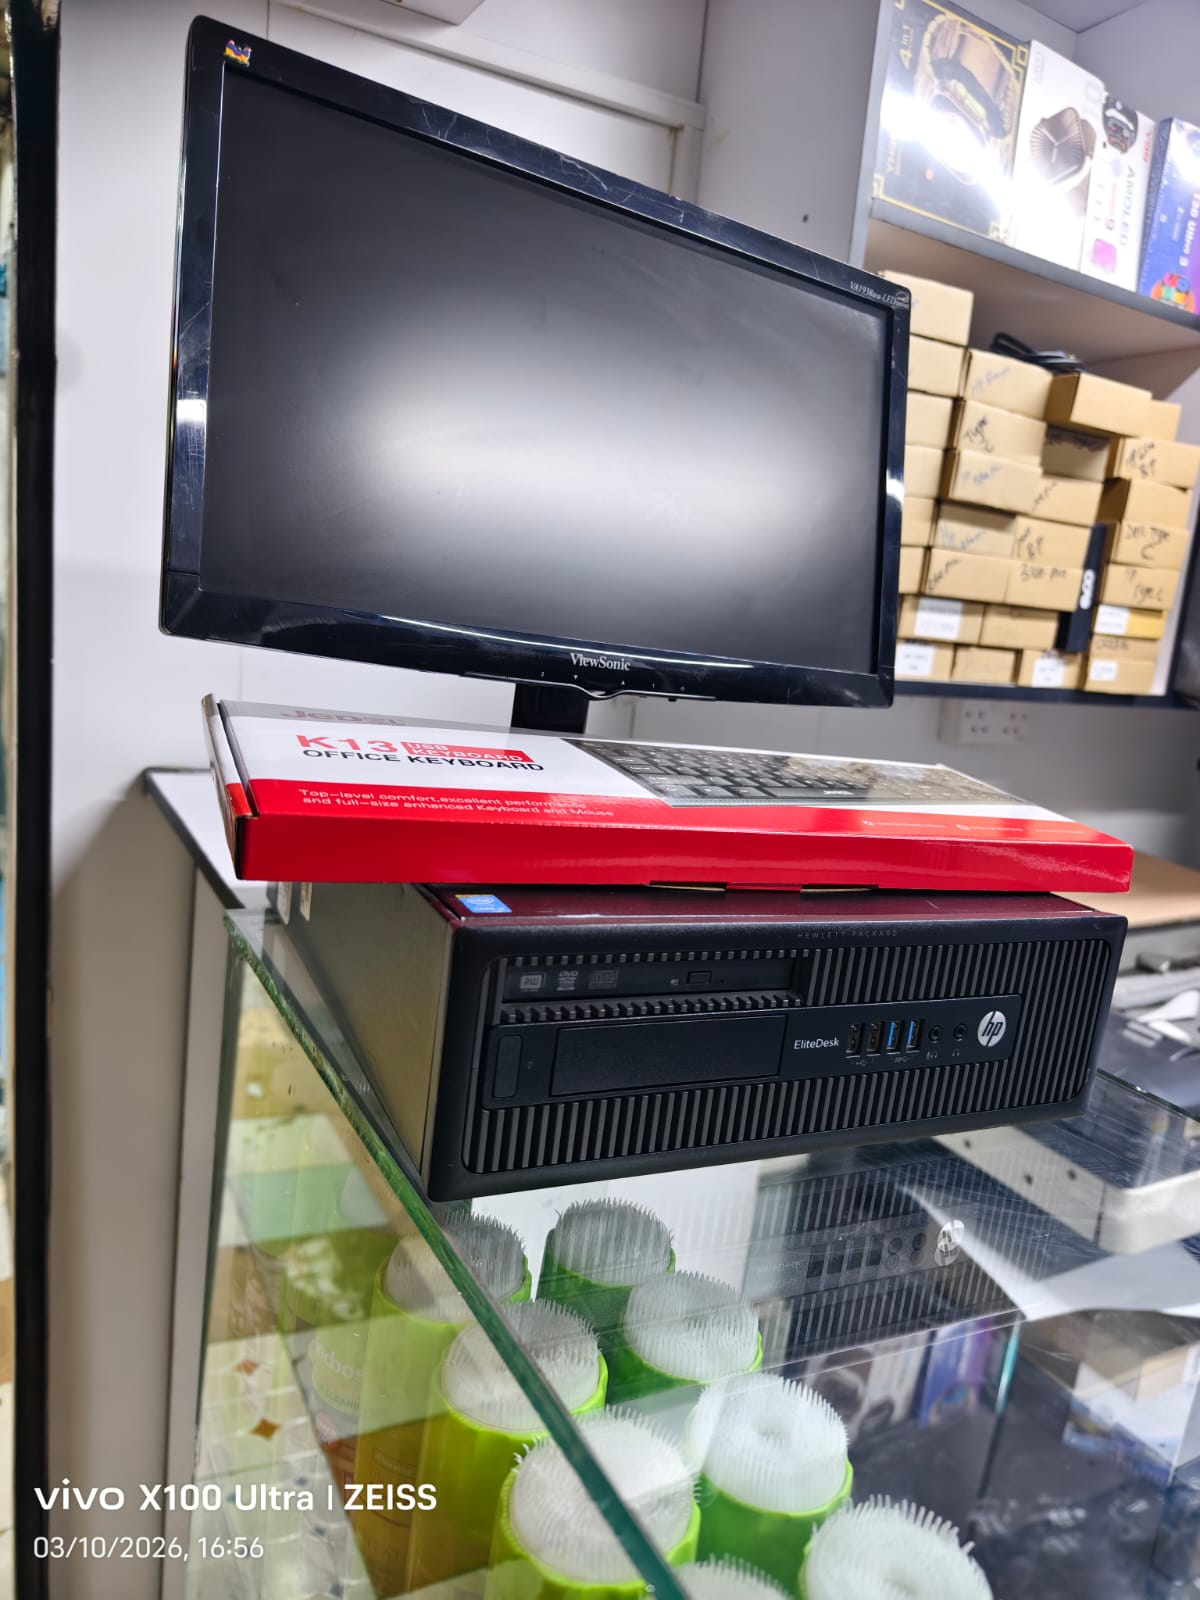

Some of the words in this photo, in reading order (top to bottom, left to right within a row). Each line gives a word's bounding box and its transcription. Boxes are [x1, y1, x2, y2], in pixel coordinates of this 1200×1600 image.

[570, 652, 631, 671] ViewSonic
[296, 734, 398, 753] K13
[405, 743, 449, 751] USB
[303, 749, 400, 762] OFFICE
[407, 755, 544, 771] KEYBOARD
[411, 748, 524, 761] KEYBOARD
[298, 789, 375, 799] Top-level
[303, 797, 331, 805] and
[335, 798, 399, 808] full-size
[403, 801, 474, 811] enhanced
[477, 804, 540, 814] Keyboard
[978, 1010, 1006, 1047] hp
[794, 1036, 839, 1049] EliteDesk
